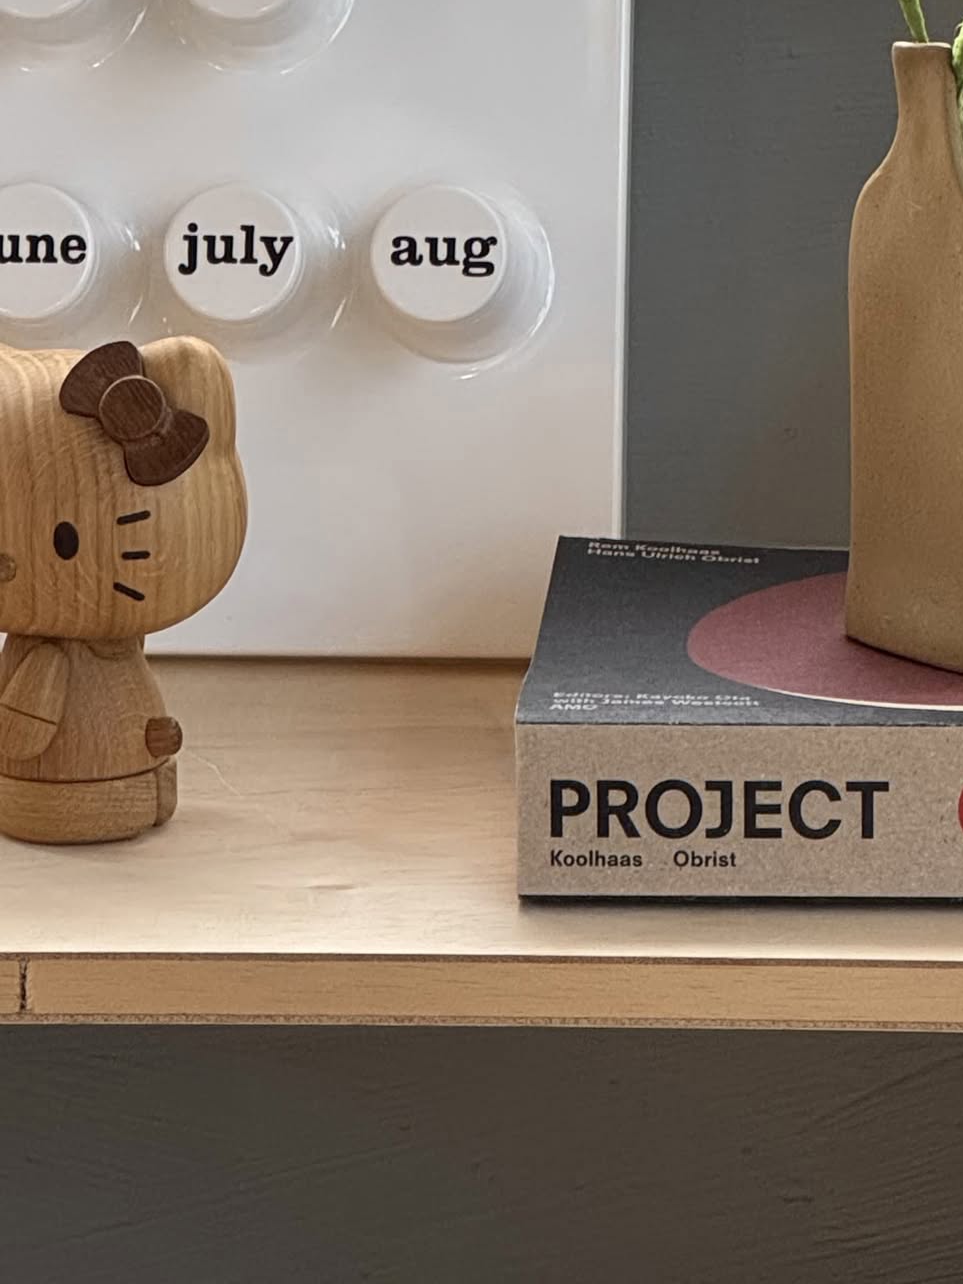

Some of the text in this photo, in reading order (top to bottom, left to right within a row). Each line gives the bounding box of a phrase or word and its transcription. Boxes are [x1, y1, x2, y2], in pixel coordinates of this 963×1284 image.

[0, 222, 498, 278] une july aug
[549, 779, 890, 840] PROJECT
[550, 849, 737, 868] Koolhaas Obrist
